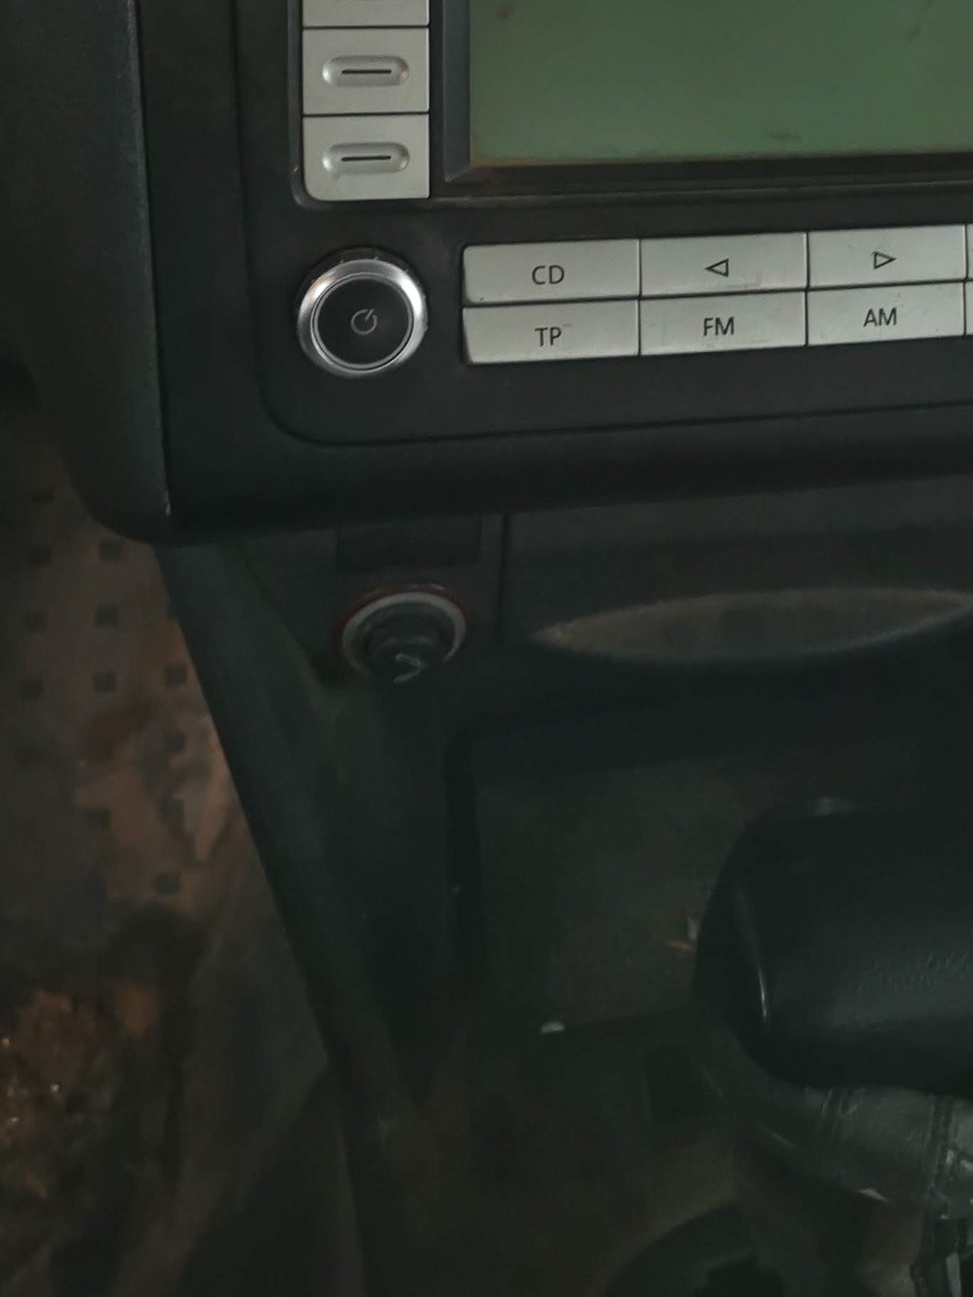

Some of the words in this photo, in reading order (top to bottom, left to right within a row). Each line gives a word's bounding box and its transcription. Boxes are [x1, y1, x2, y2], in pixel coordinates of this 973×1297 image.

[531, 265, 565, 285] CD
[703, 316, 735, 337] FM
[863, 308, 898, 328] AM
[534, 326, 562, 347] TP
